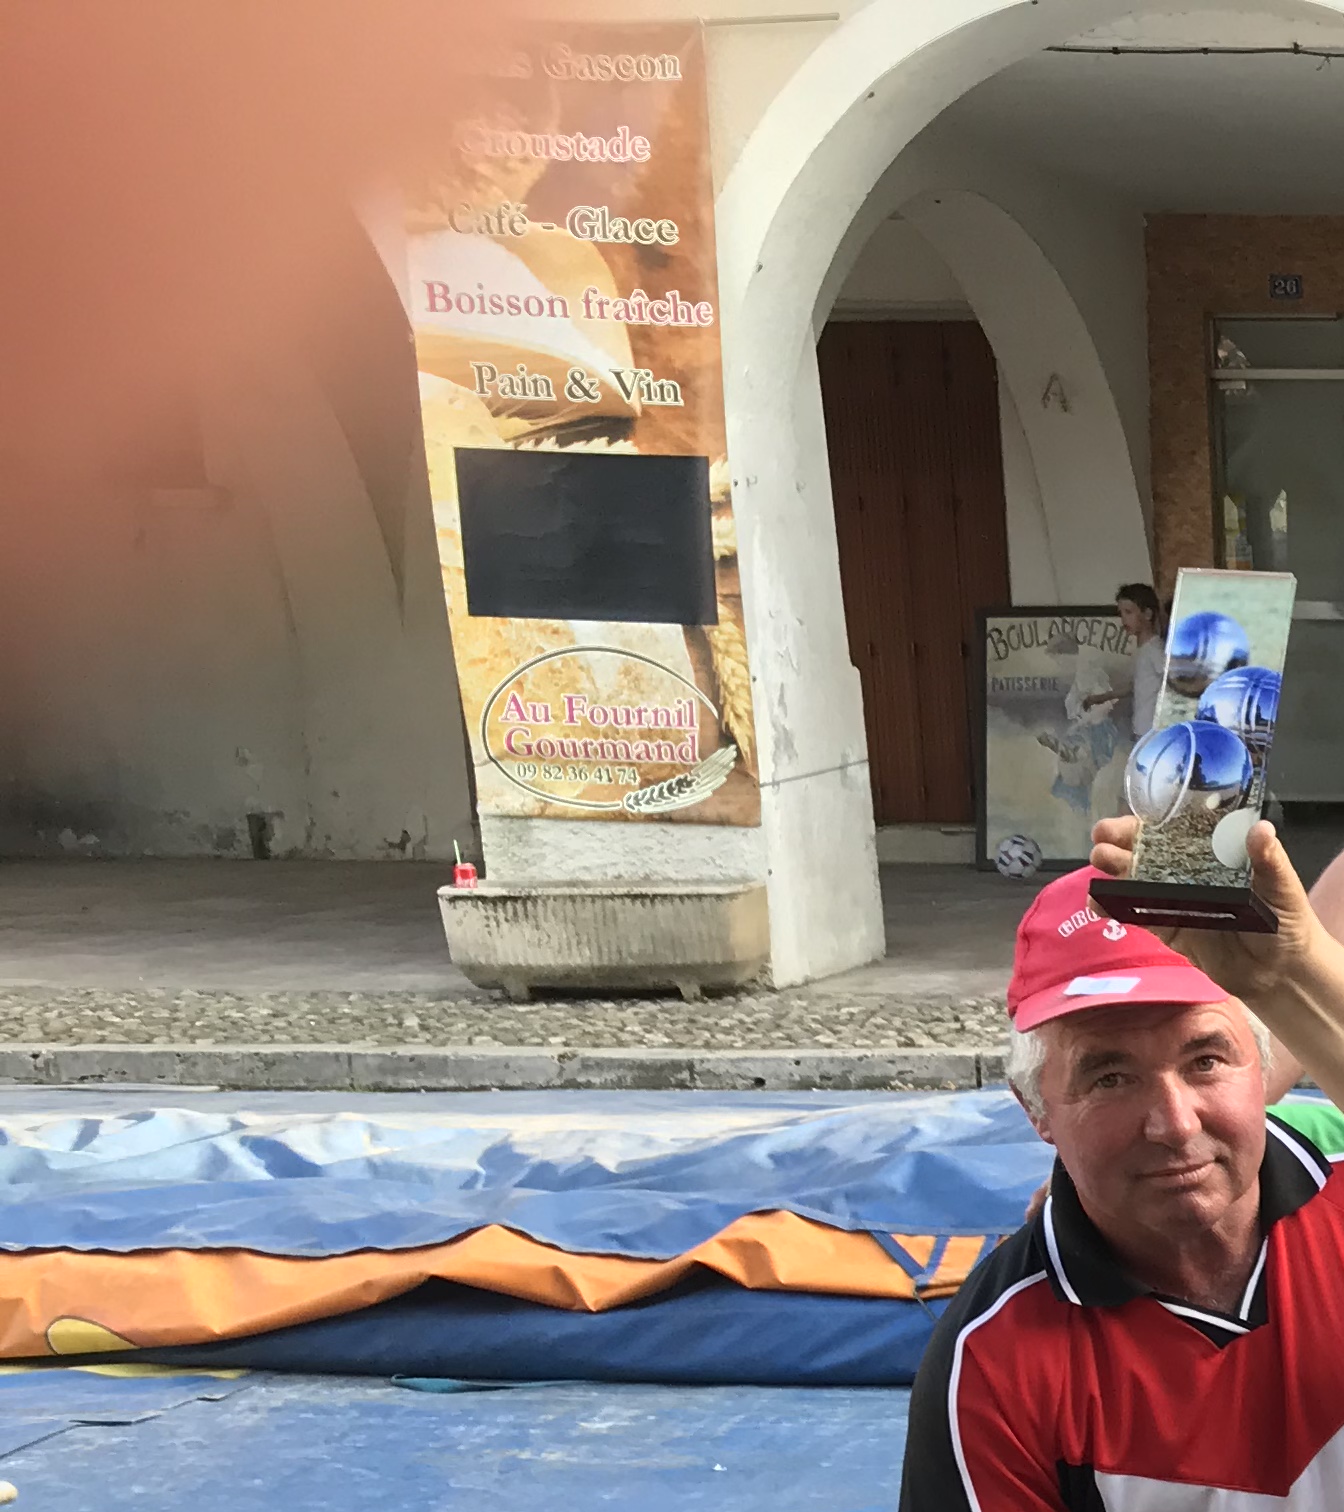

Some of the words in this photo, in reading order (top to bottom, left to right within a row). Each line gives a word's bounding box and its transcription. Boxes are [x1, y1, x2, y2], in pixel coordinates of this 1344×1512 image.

[542, 43, 683, 81] Gascon
[448, 200, 528, 237] Café
[567, 205, 680, 245] Glace
[423, 279, 570, 319] Boisson
[582, 286, 714, 327] fraîche
[1274, 279, 1297, 295] 26
[471, 361, 556, 400] Pain
[565, 368, 601, 403] &
[610, 369, 684, 406] Vin
[987, 618, 1132, 661] BOULANGERIE
[500, 692, 552, 724] Au
[562, 693, 699, 730] Fournil
[504, 727, 701, 763] Gourmand
[516, 762, 537, 778] 09
[542, 764, 563, 780] 82
[567, 765, 589, 782] 36
[594, 766, 613, 783] 41
[617, 767, 639, 784] 74
